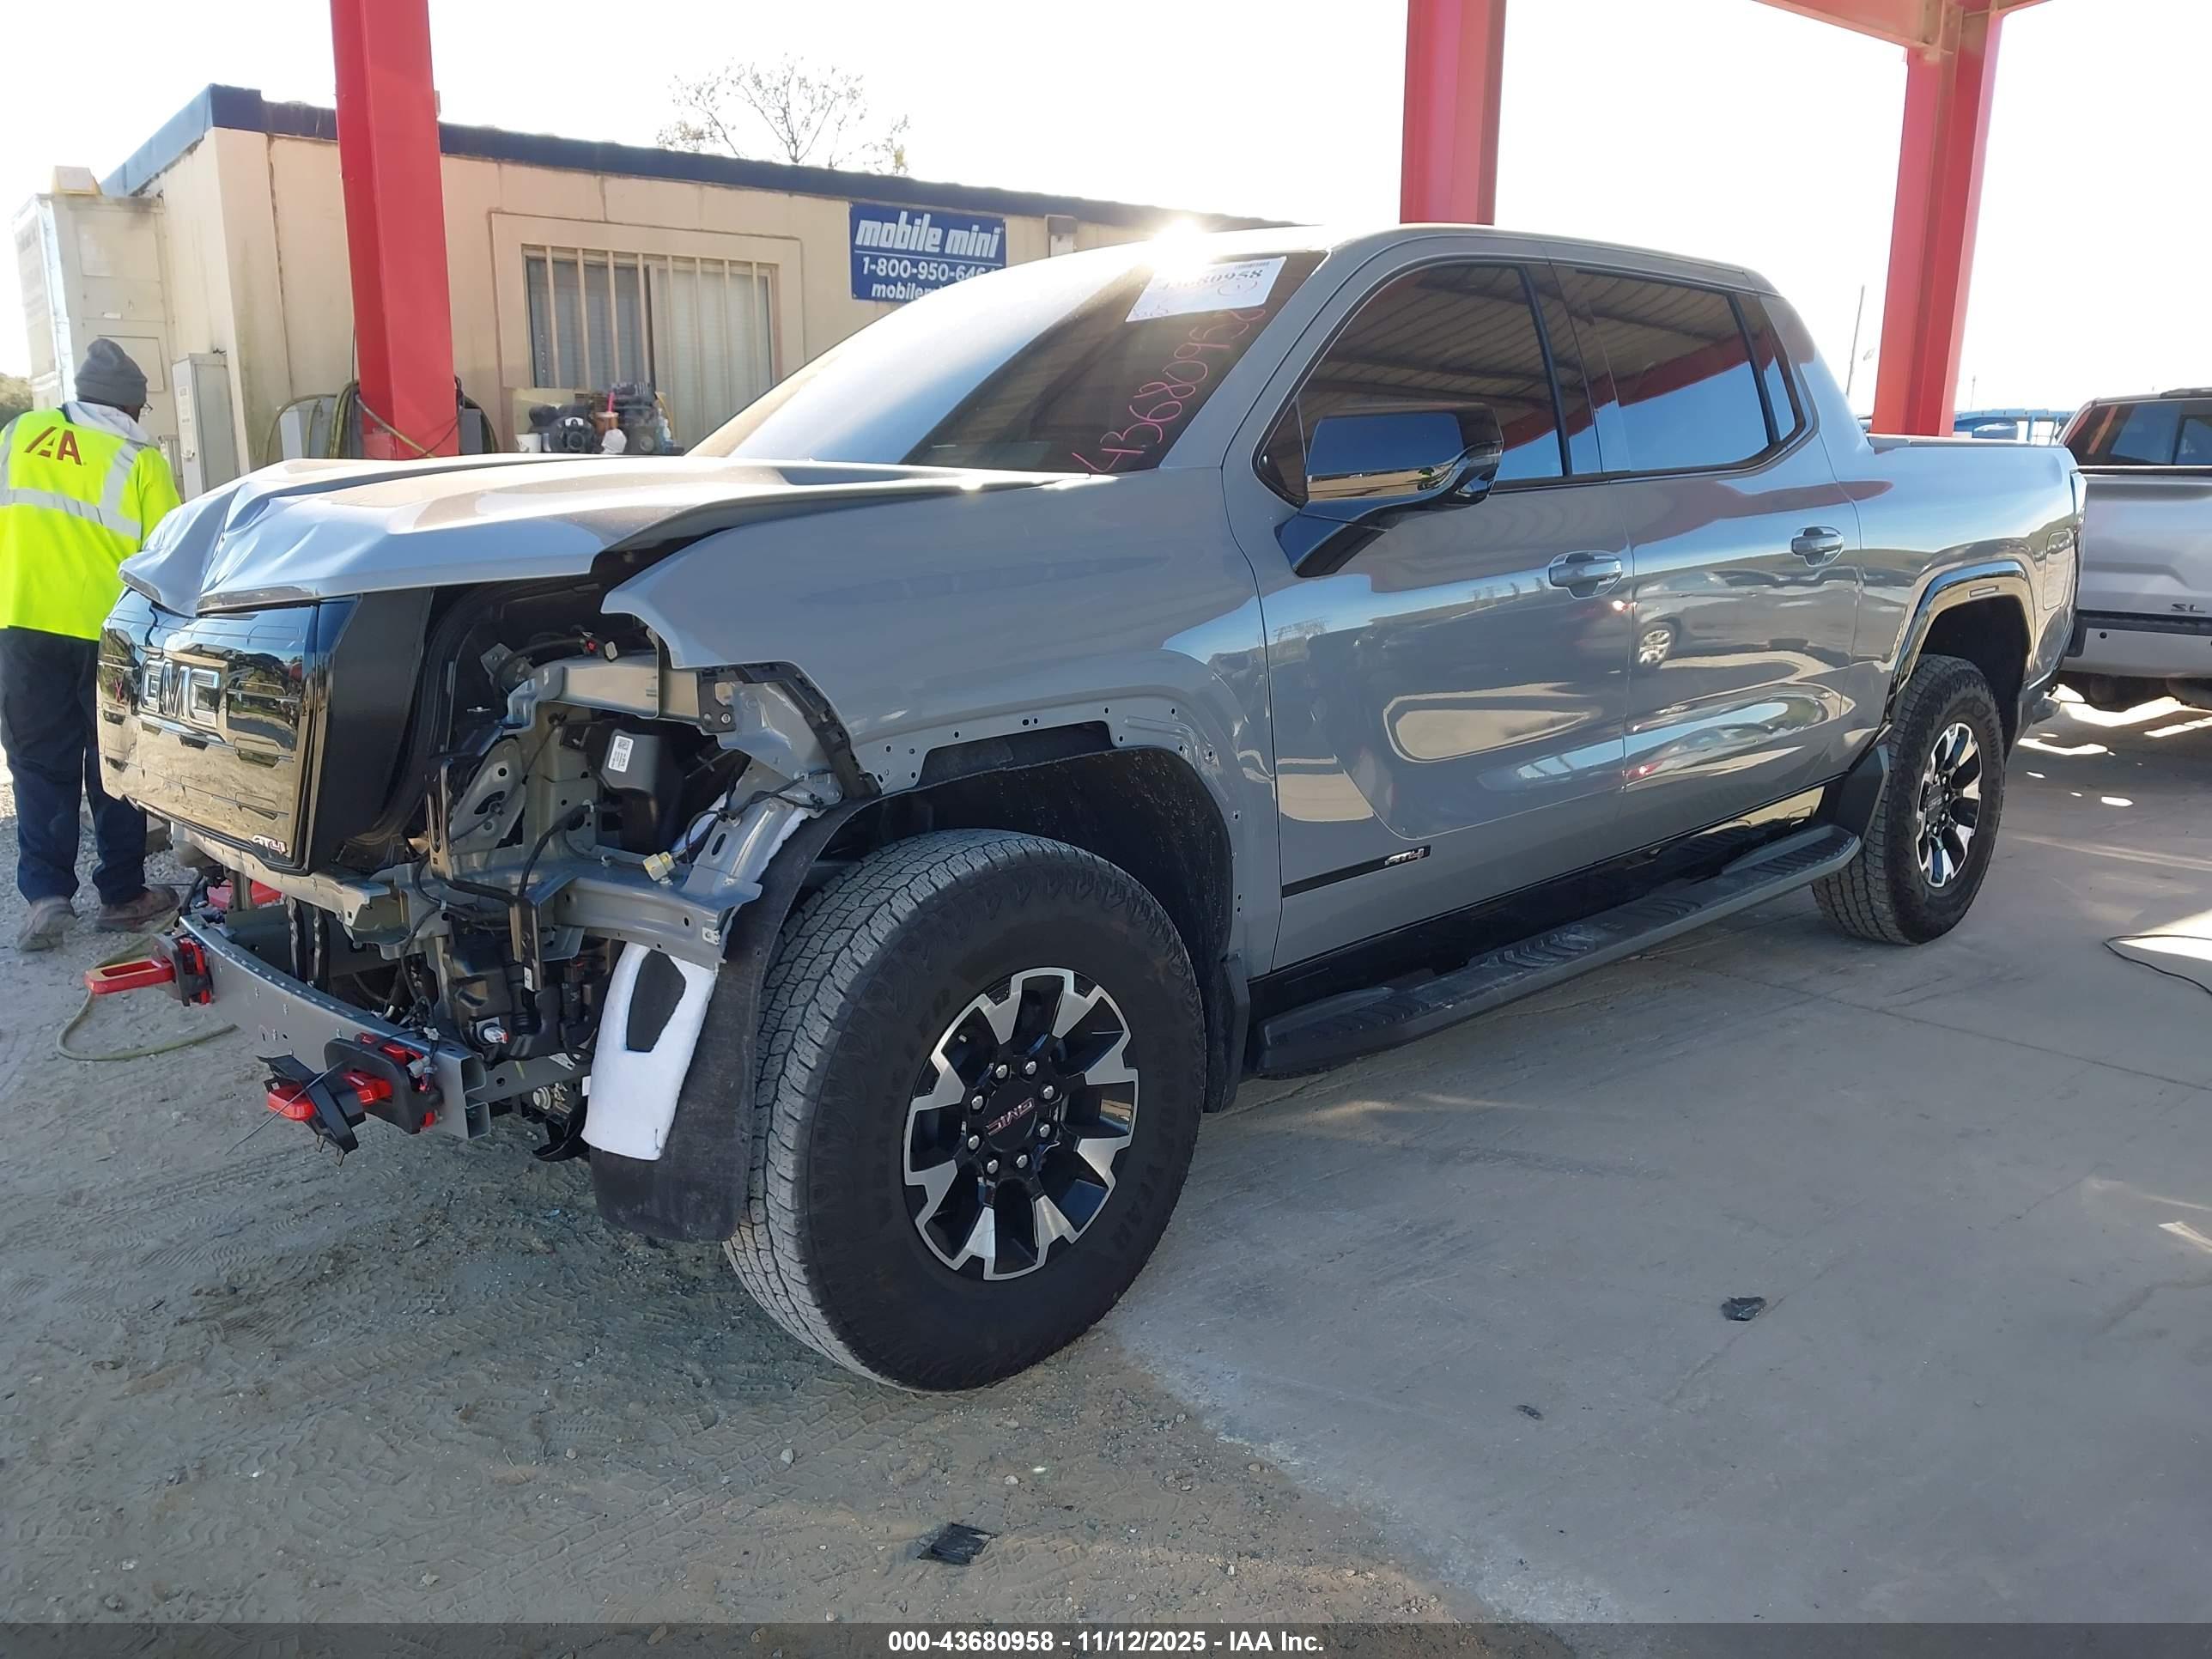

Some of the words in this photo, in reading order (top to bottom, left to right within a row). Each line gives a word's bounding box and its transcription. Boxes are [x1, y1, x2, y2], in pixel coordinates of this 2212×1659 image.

[855, 211, 942, 252] mobile
[945, 225, 1000, 258] mini
[862, 257, 996, 282] 1-800-950-64
[141, 659, 221, 729] GMC
